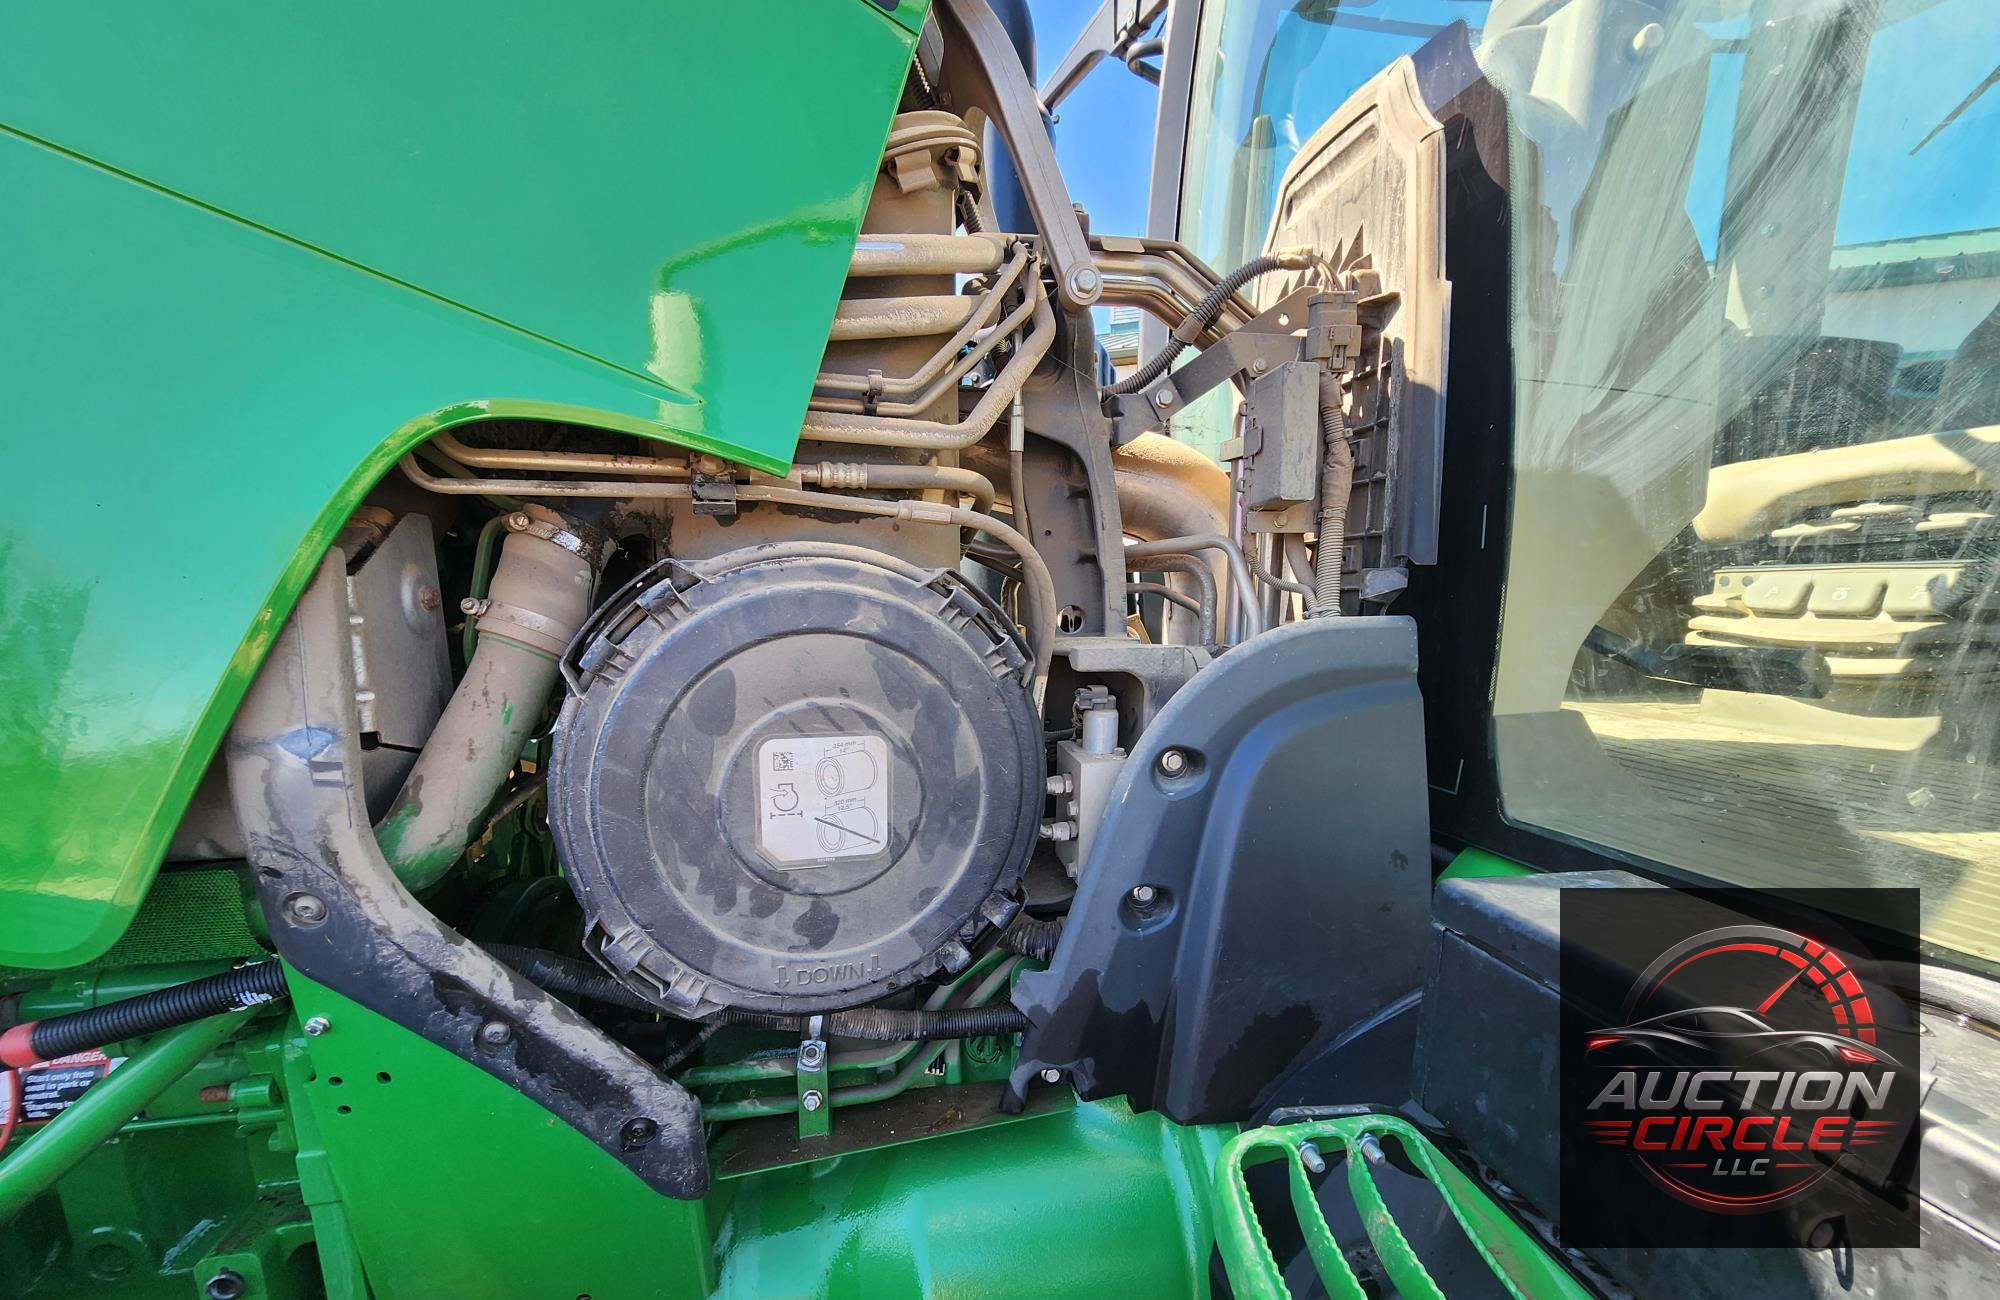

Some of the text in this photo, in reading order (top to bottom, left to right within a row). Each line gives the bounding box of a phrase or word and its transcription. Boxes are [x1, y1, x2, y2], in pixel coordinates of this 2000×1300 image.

[796, 962, 865, 986] DOWN
[26, 1070, 95, 1083] Start only from
[57, 1080, 78, 1090] park
[79, 1079, 92, 1087] or
[25, 1101, 64, 1112] Starting
